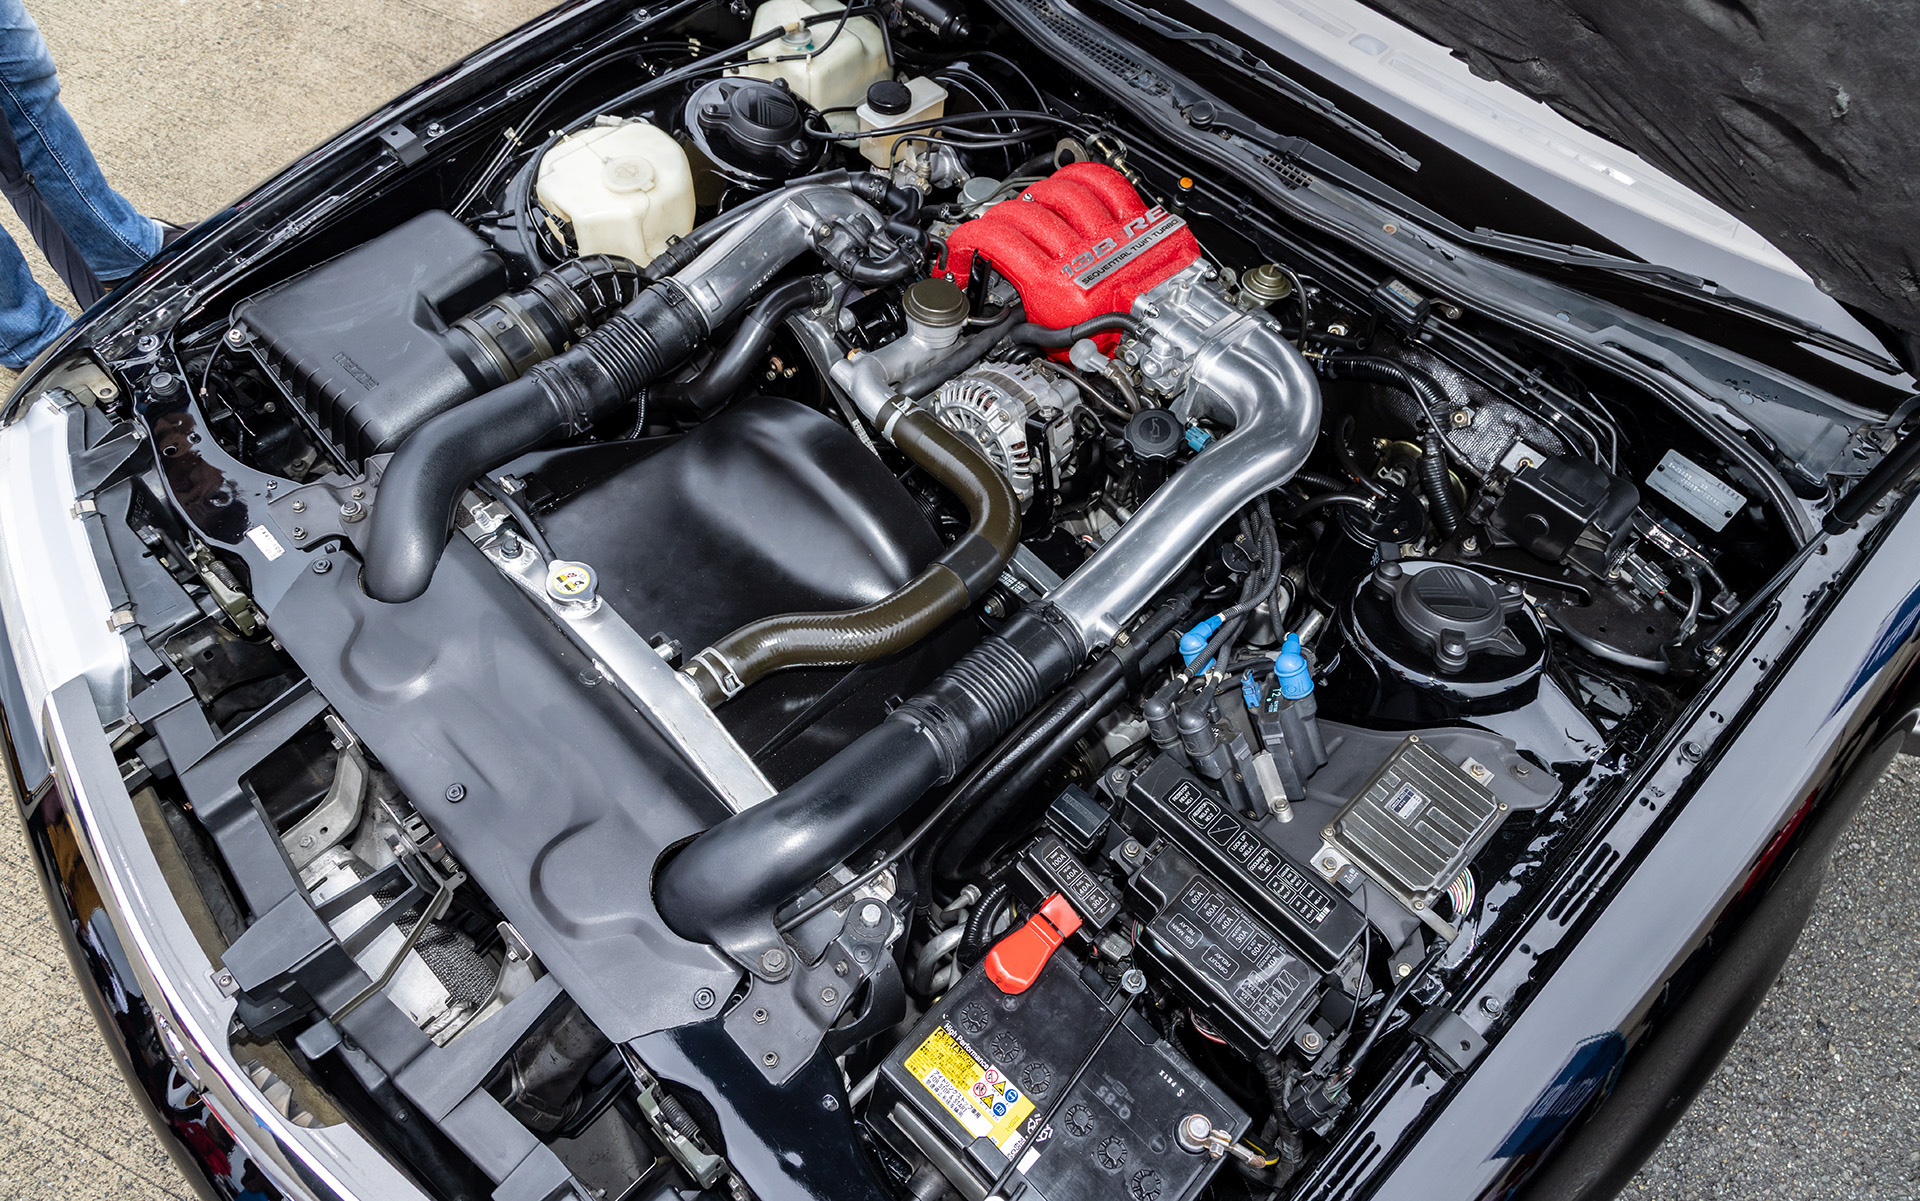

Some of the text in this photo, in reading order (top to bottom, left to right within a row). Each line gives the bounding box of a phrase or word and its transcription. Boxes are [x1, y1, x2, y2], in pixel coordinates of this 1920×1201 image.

[1061, 204, 1168, 277] 13B RE
[1081, 219, 1179, 285] SEQUENTIAL TWIN TURBO
[1178, 790, 1190, 803] RELAY
[1062, 794, 1099, 825] DIAGNOSIS
[1198, 807, 1210, 819] RELAY
[1230, 840, 1242, 851] LOCK
[1242, 845, 1254, 857] RELAY
[1051, 853, 1066, 867] 100A
[1257, 858, 1269, 870] RELAY
[1066, 868, 1078, 880] 40A
[1079, 882, 1091, 894] 40A
[1091, 896, 1104, 909] 30A
[1190, 891, 1204, 904] 60A
[1205, 904, 1218, 917] 60A
[1171, 923, 1185, 936] MAIN
[1179, 921, 1195, 936] RELAY
[1221, 917, 1233, 929] 40A
[1235, 930, 1248, 943] 30A
[1250, 943, 1264, 956] 60A
[1208, 956, 1228, 974] CIRCUIT
[1214, 952, 1231, 967] RELAY
[1258, 1007, 1267, 1017] 10A
[943, 1022, 989, 1069] High Performance
[929, 1074, 939, 1084] FOR
[938, 1083, 950, 1094] STOP
[952, 1098, 967, 1112] START
[1176, 1088, 1185, 1097] S
[1096, 1085, 1130, 1119] Q-85
